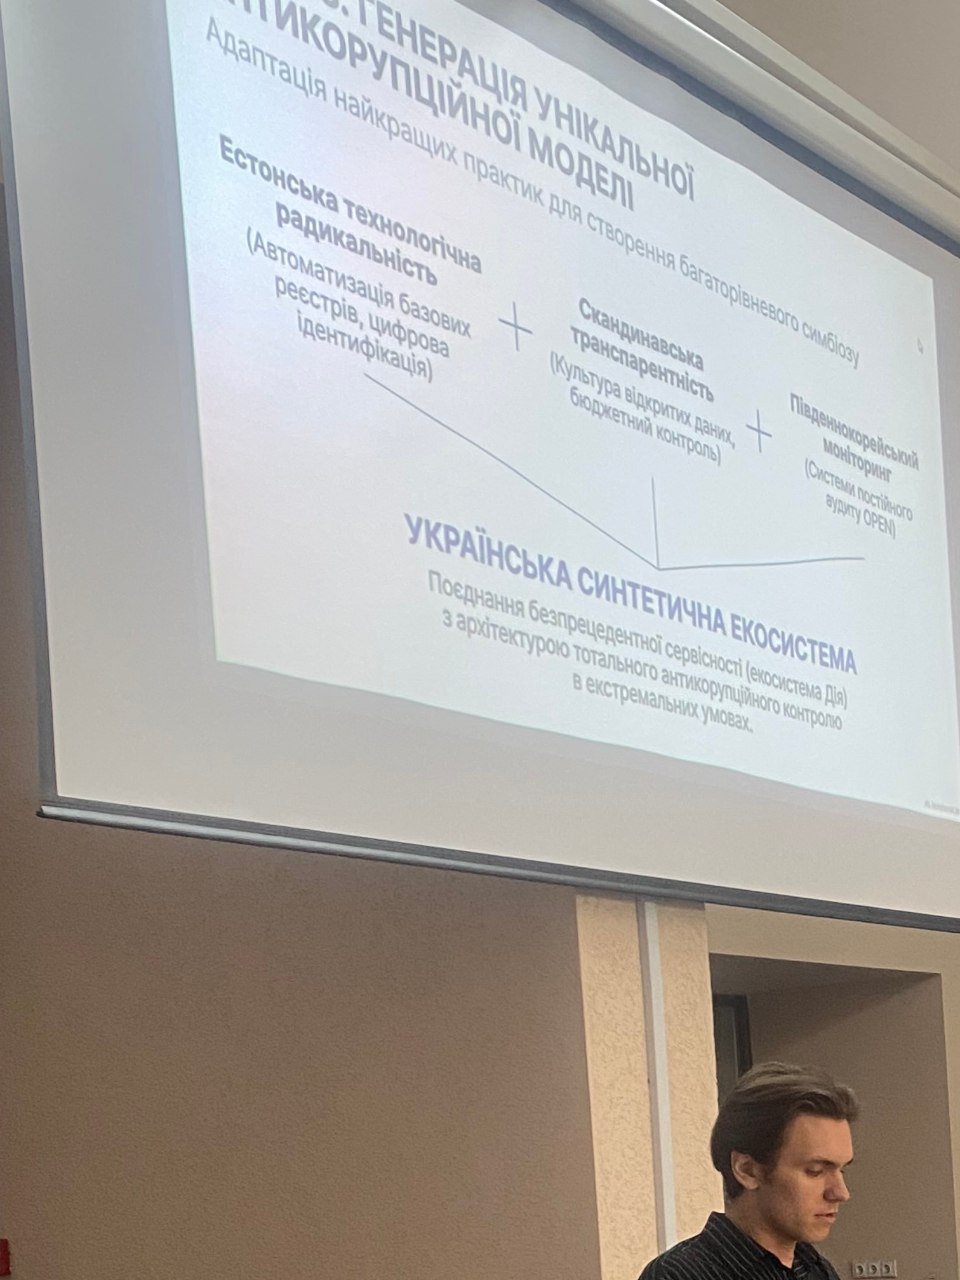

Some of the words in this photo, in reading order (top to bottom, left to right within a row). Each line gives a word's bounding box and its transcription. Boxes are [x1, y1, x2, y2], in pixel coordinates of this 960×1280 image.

[528, 127, 635, 212] МОДЕЛІ
[533, 85, 695, 201] УНІКАЛЬНОЇ
[206, 16, 327, 102] Адаптація
[334, 87, 458, 166] найкращих
[463, 151, 545, 208] практик
[548, 193, 583, 225] для
[587, 212, 676, 271] створення
[680, 254, 800, 333] багаторівневого
[802, 320, 861, 370] симбіозу
[219, 134, 339, 213] Естонська
[343, 198, 483, 274] технологічна
[246, 226, 395, 309] (Автоматизація
[399, 292, 472, 340] базових
[275, 201, 438, 286] радикальність
[275, 275, 365, 331] реєстрів,
[368, 312, 450, 358] цифрова
[297, 309, 433, 384] ідентифікація)
[579, 297, 704, 372] Скандинавська
[550, 351, 622, 399] (Культура
[625, 386, 692, 428] відкритих
[694, 416, 736, 450] даних,
[570, 325, 715, 403] транспарентність
[570, 385, 653, 438] бюджетний
[656, 424, 722, 467] контроль)
[790, 392, 920, 471] Південнокорейський
[823, 437, 892, 483] моніторинг
[805, 458, 856, 497] (Системи
[858, 487, 914, 522] постійного
[826, 493, 861, 525] аудиту
[403, 512, 573, 592] УКРАЇНСЬКА
[577, 566, 728, 637] СИНТЕТИЧНА
[730, 613, 858, 676] ЕКОСИСТЕМА
[428, 569, 526, 619] Поєднання
[528, 599, 663, 655] безпрецедентної
[665, 640, 743, 678] сервісності
[745, 660, 823, 700] (екосистема
[825, 684, 848, 711] Дія)
[441, 608, 453, 628] з
[456, 612, 571, 658] архітектурою
[573, 643, 658, 681] тотального
[661, 668, 781, 715] антикорупційного
[783, 702, 843, 731] контролю
[572, 673, 583, 691] в
[585, 677, 699, 719] екстремальних
[701, 704, 753, 733] умовах.
